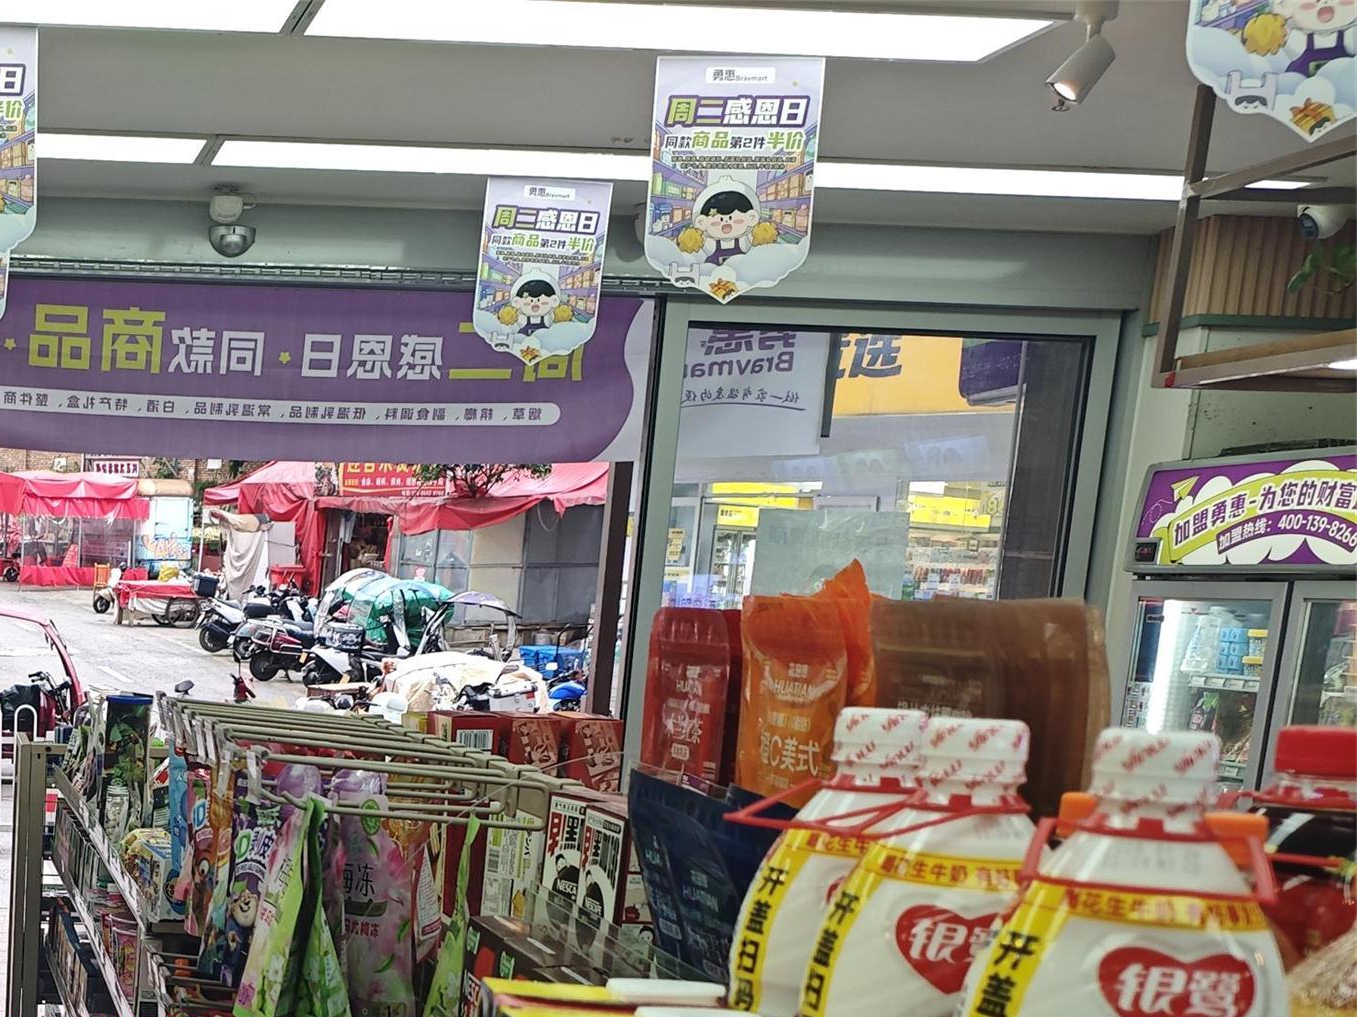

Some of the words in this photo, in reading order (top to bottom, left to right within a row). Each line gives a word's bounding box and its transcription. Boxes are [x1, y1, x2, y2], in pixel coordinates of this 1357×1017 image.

[664, 95, 811, 128] 周二感恩日
[664, 130, 805, 150] 同款商品第2件半价
[491, 205, 600, 235] 周二感恩日
[1174, 480, 1357, 548] 加盟勇惠-为您的财富
